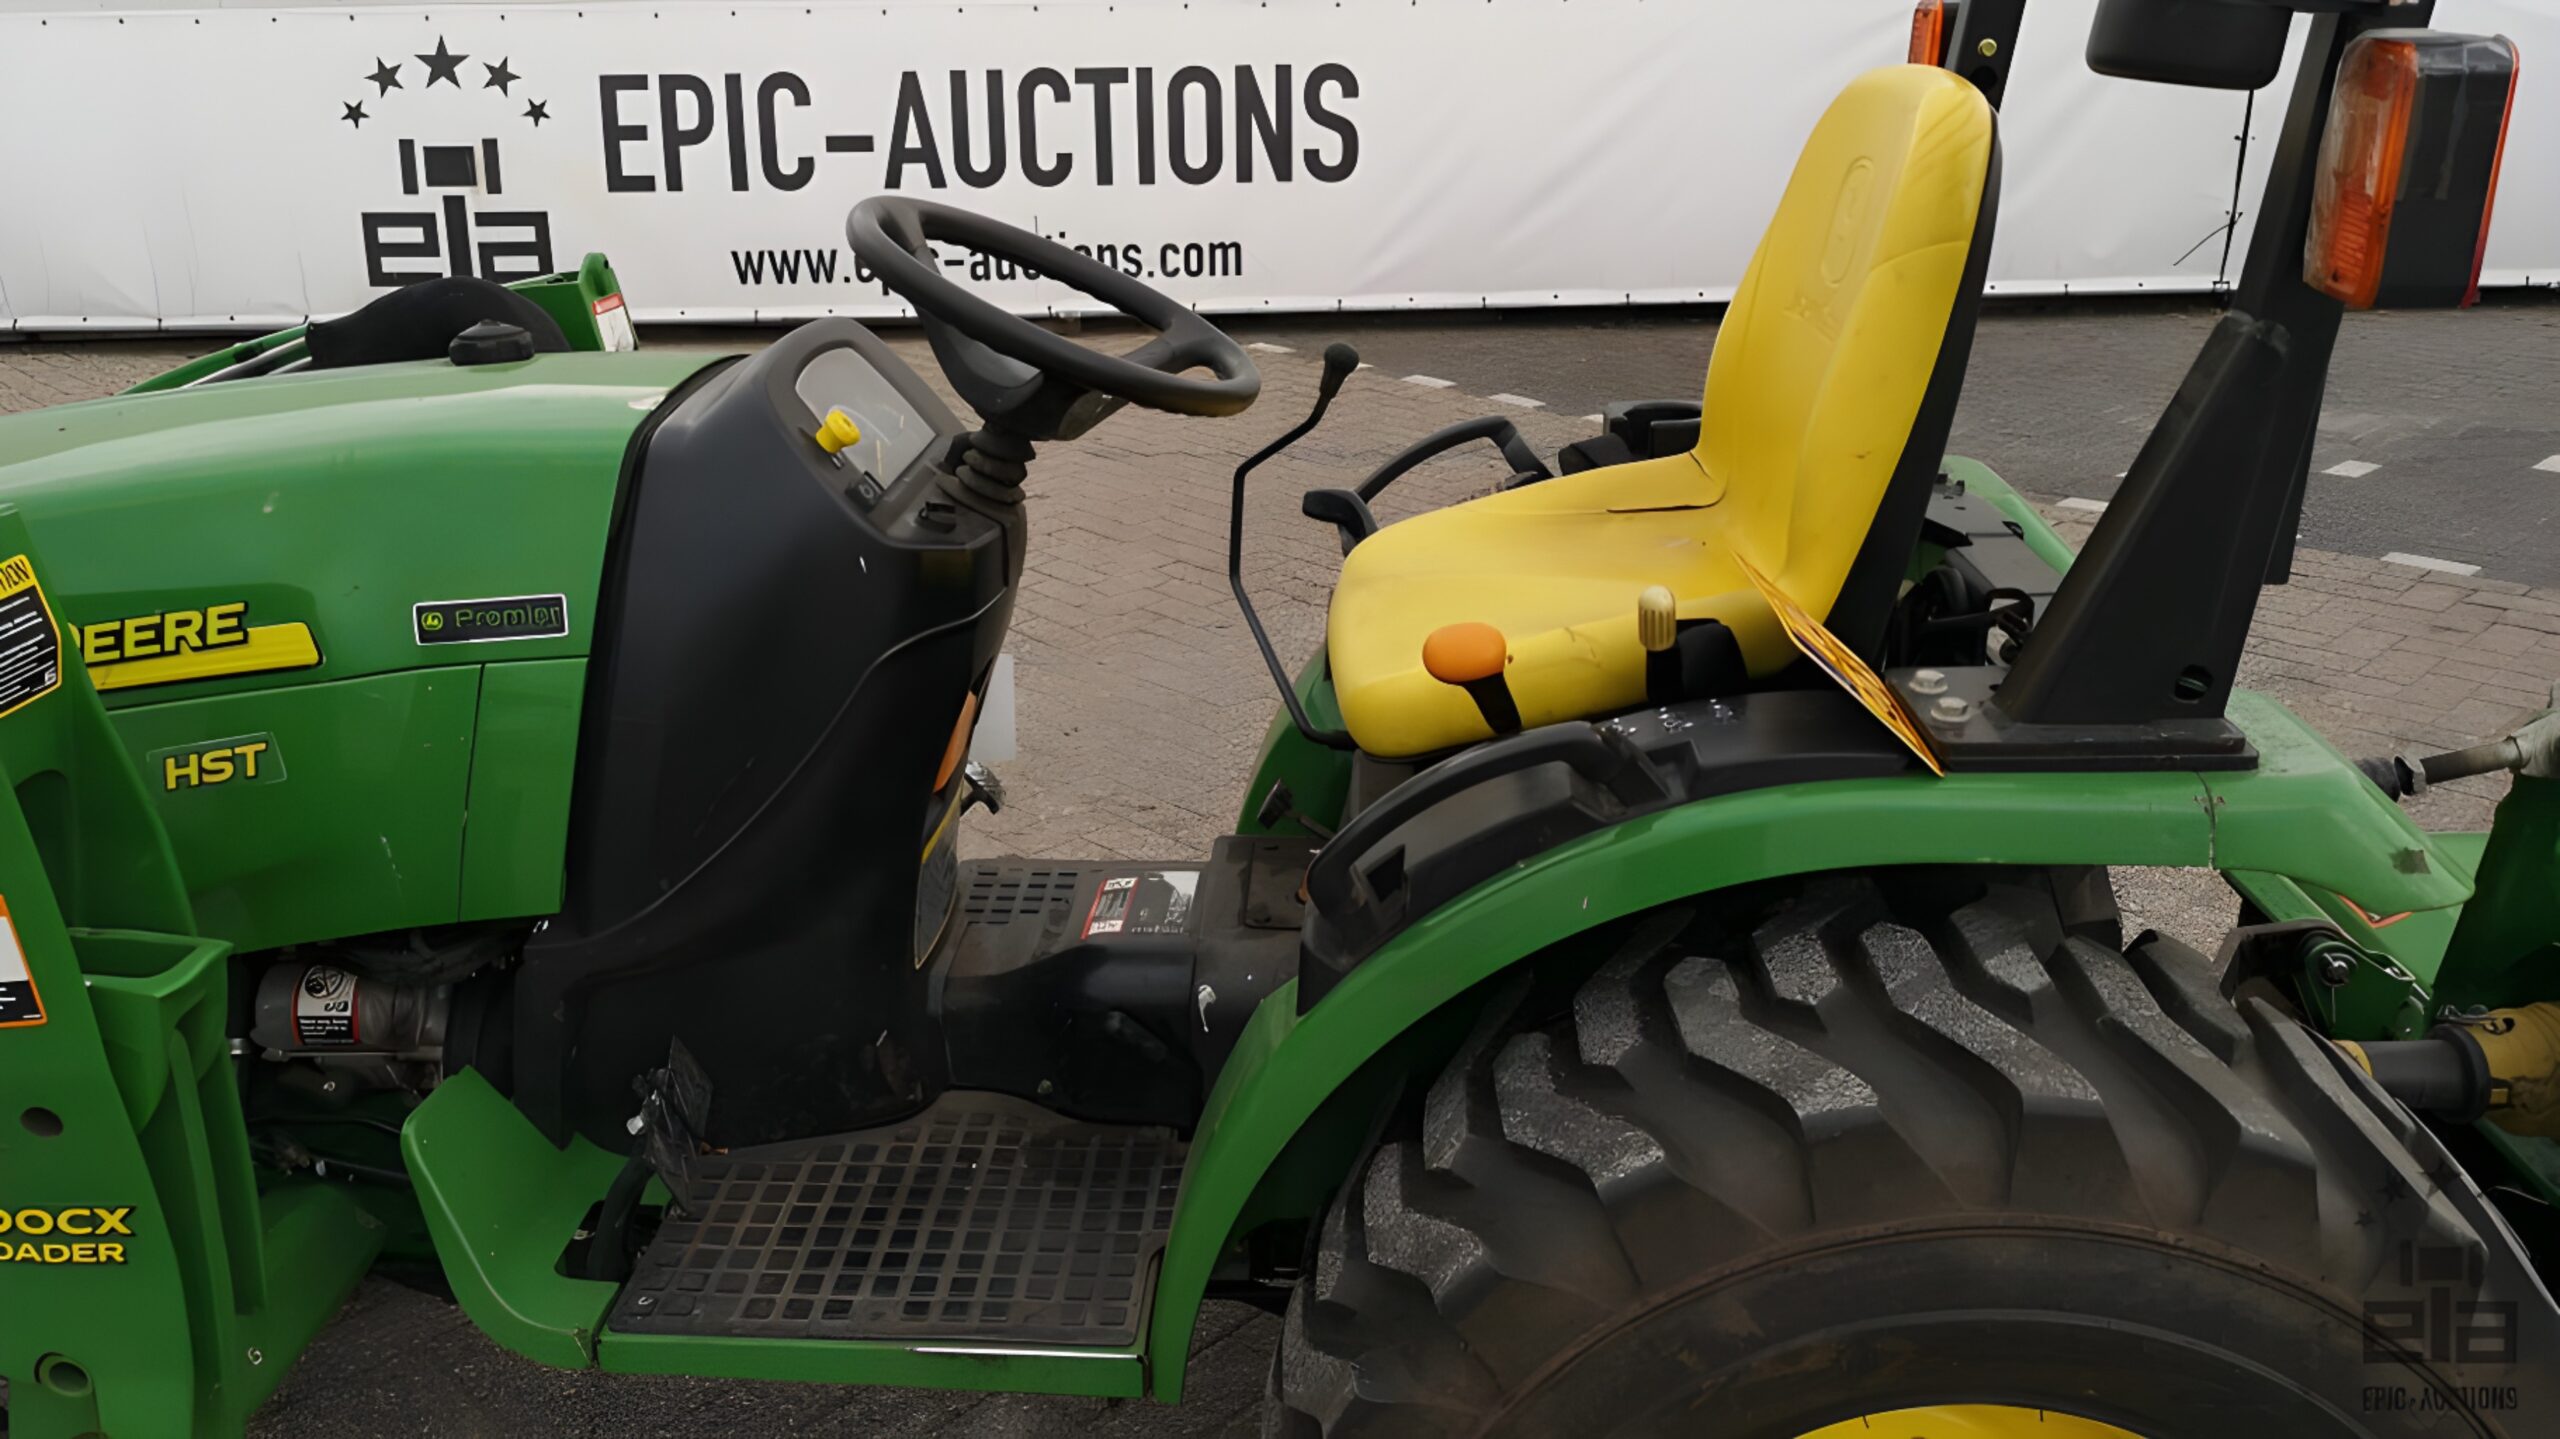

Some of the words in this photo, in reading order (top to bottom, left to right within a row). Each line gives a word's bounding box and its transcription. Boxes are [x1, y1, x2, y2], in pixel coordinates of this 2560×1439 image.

[598, 63, 1360, 193] EPIC-AUCTIONS
[730, 232, 1243, 296] www.e-auns.com
[68, 602, 246, 664] EERE
[164, 742, 267, 791] HST
